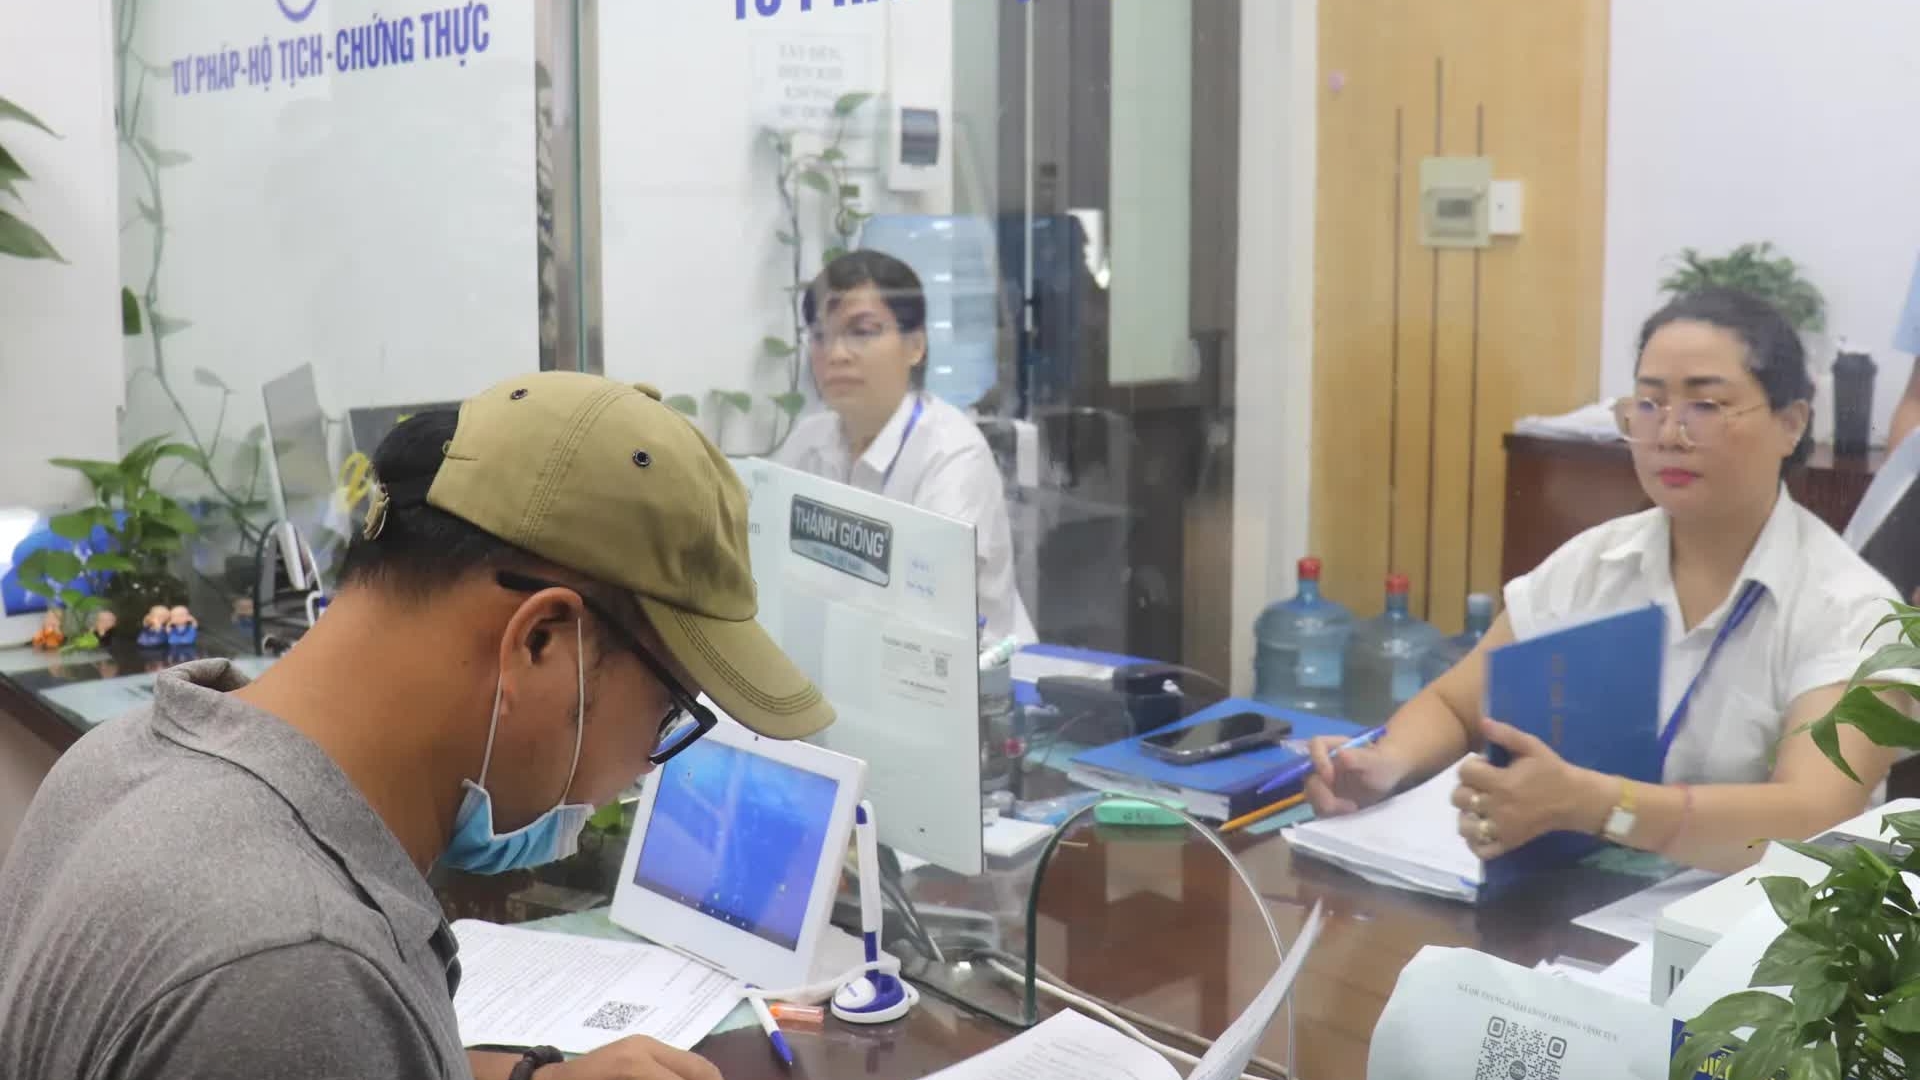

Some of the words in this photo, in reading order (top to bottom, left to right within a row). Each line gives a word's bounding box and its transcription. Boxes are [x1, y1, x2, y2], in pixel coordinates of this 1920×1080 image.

[172, 54, 192, 95] TƯ
[421, 1, 489, 66] THỰC
[795, 505, 838, 542] THÁNH
[840, 521, 884, 558] GIÓNG
